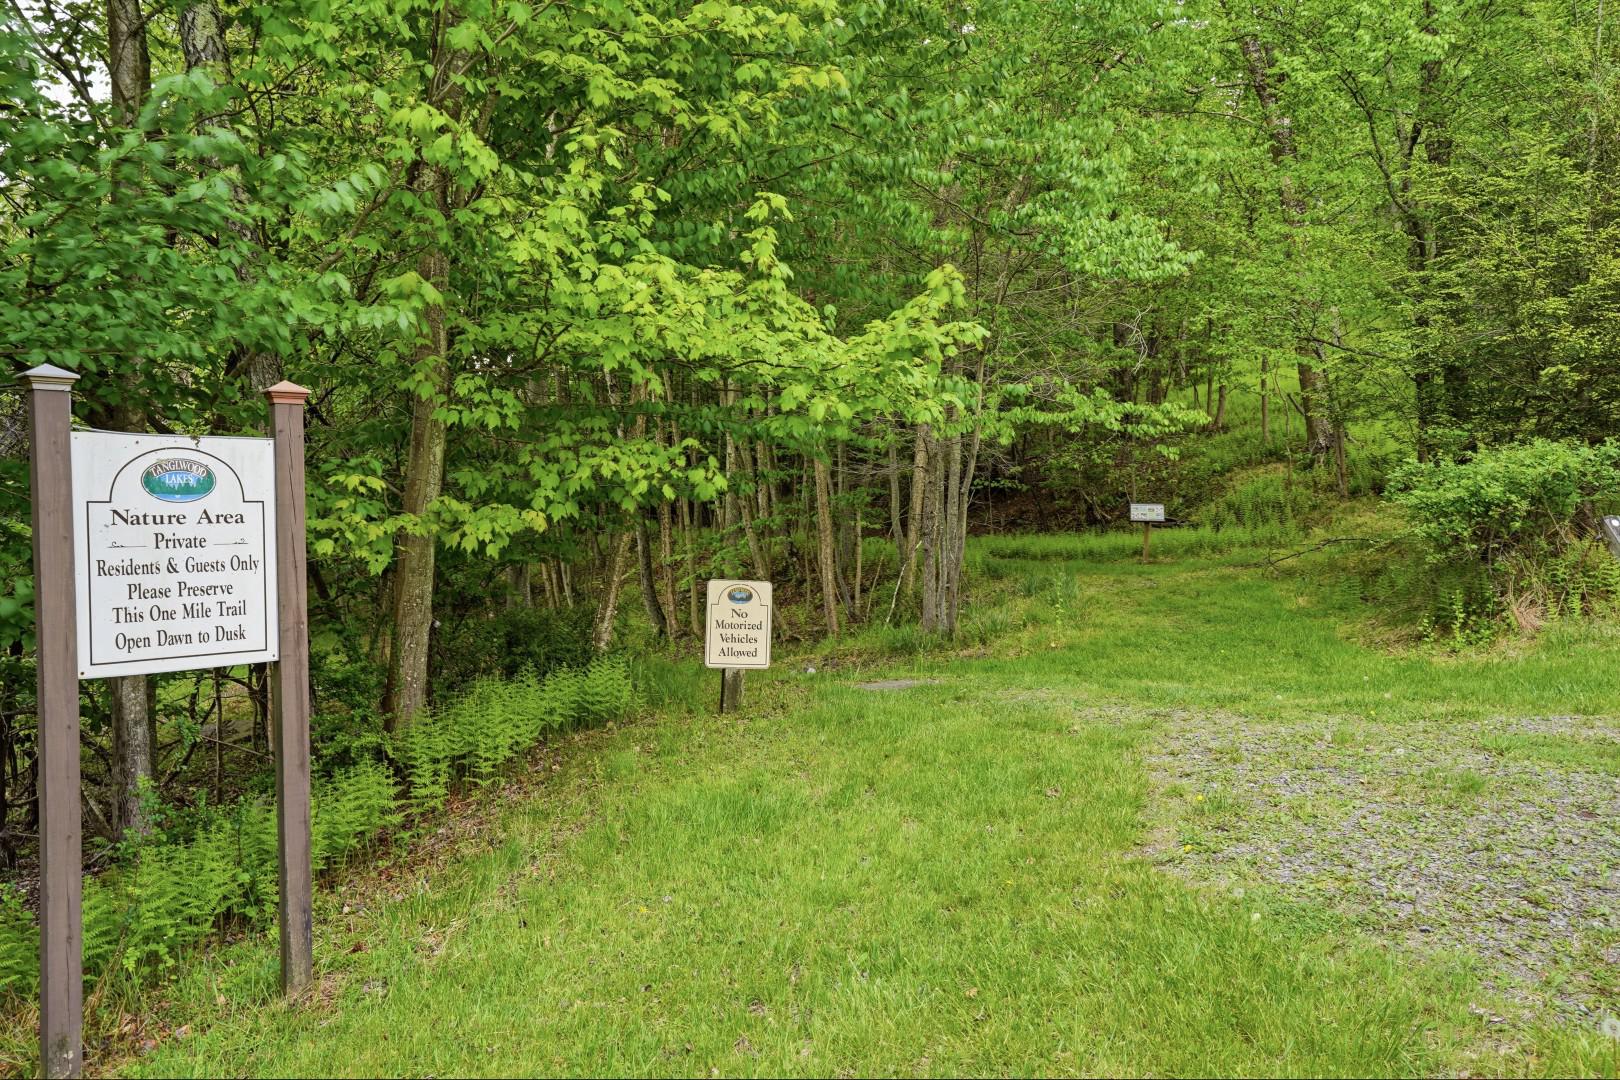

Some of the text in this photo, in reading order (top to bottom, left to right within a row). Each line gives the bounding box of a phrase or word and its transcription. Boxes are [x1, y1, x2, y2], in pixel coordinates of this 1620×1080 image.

[165, 474, 193, 483] LAKES
[111, 509, 245, 525] Nature Area
[154, 532, 206, 549] Private
[96, 555, 259, 577] Residents & Guests Only
[127, 581, 233, 600] Please Preserve
[112, 600, 246, 624] This One Mile Trail
[731, 609, 748, 618] No
[715, 620, 762, 630] Motorized
[115, 624, 246, 653] Open Dawn to Dusk
[720, 633, 757, 643] Vehicles
[718, 647, 757, 657] Allowed
